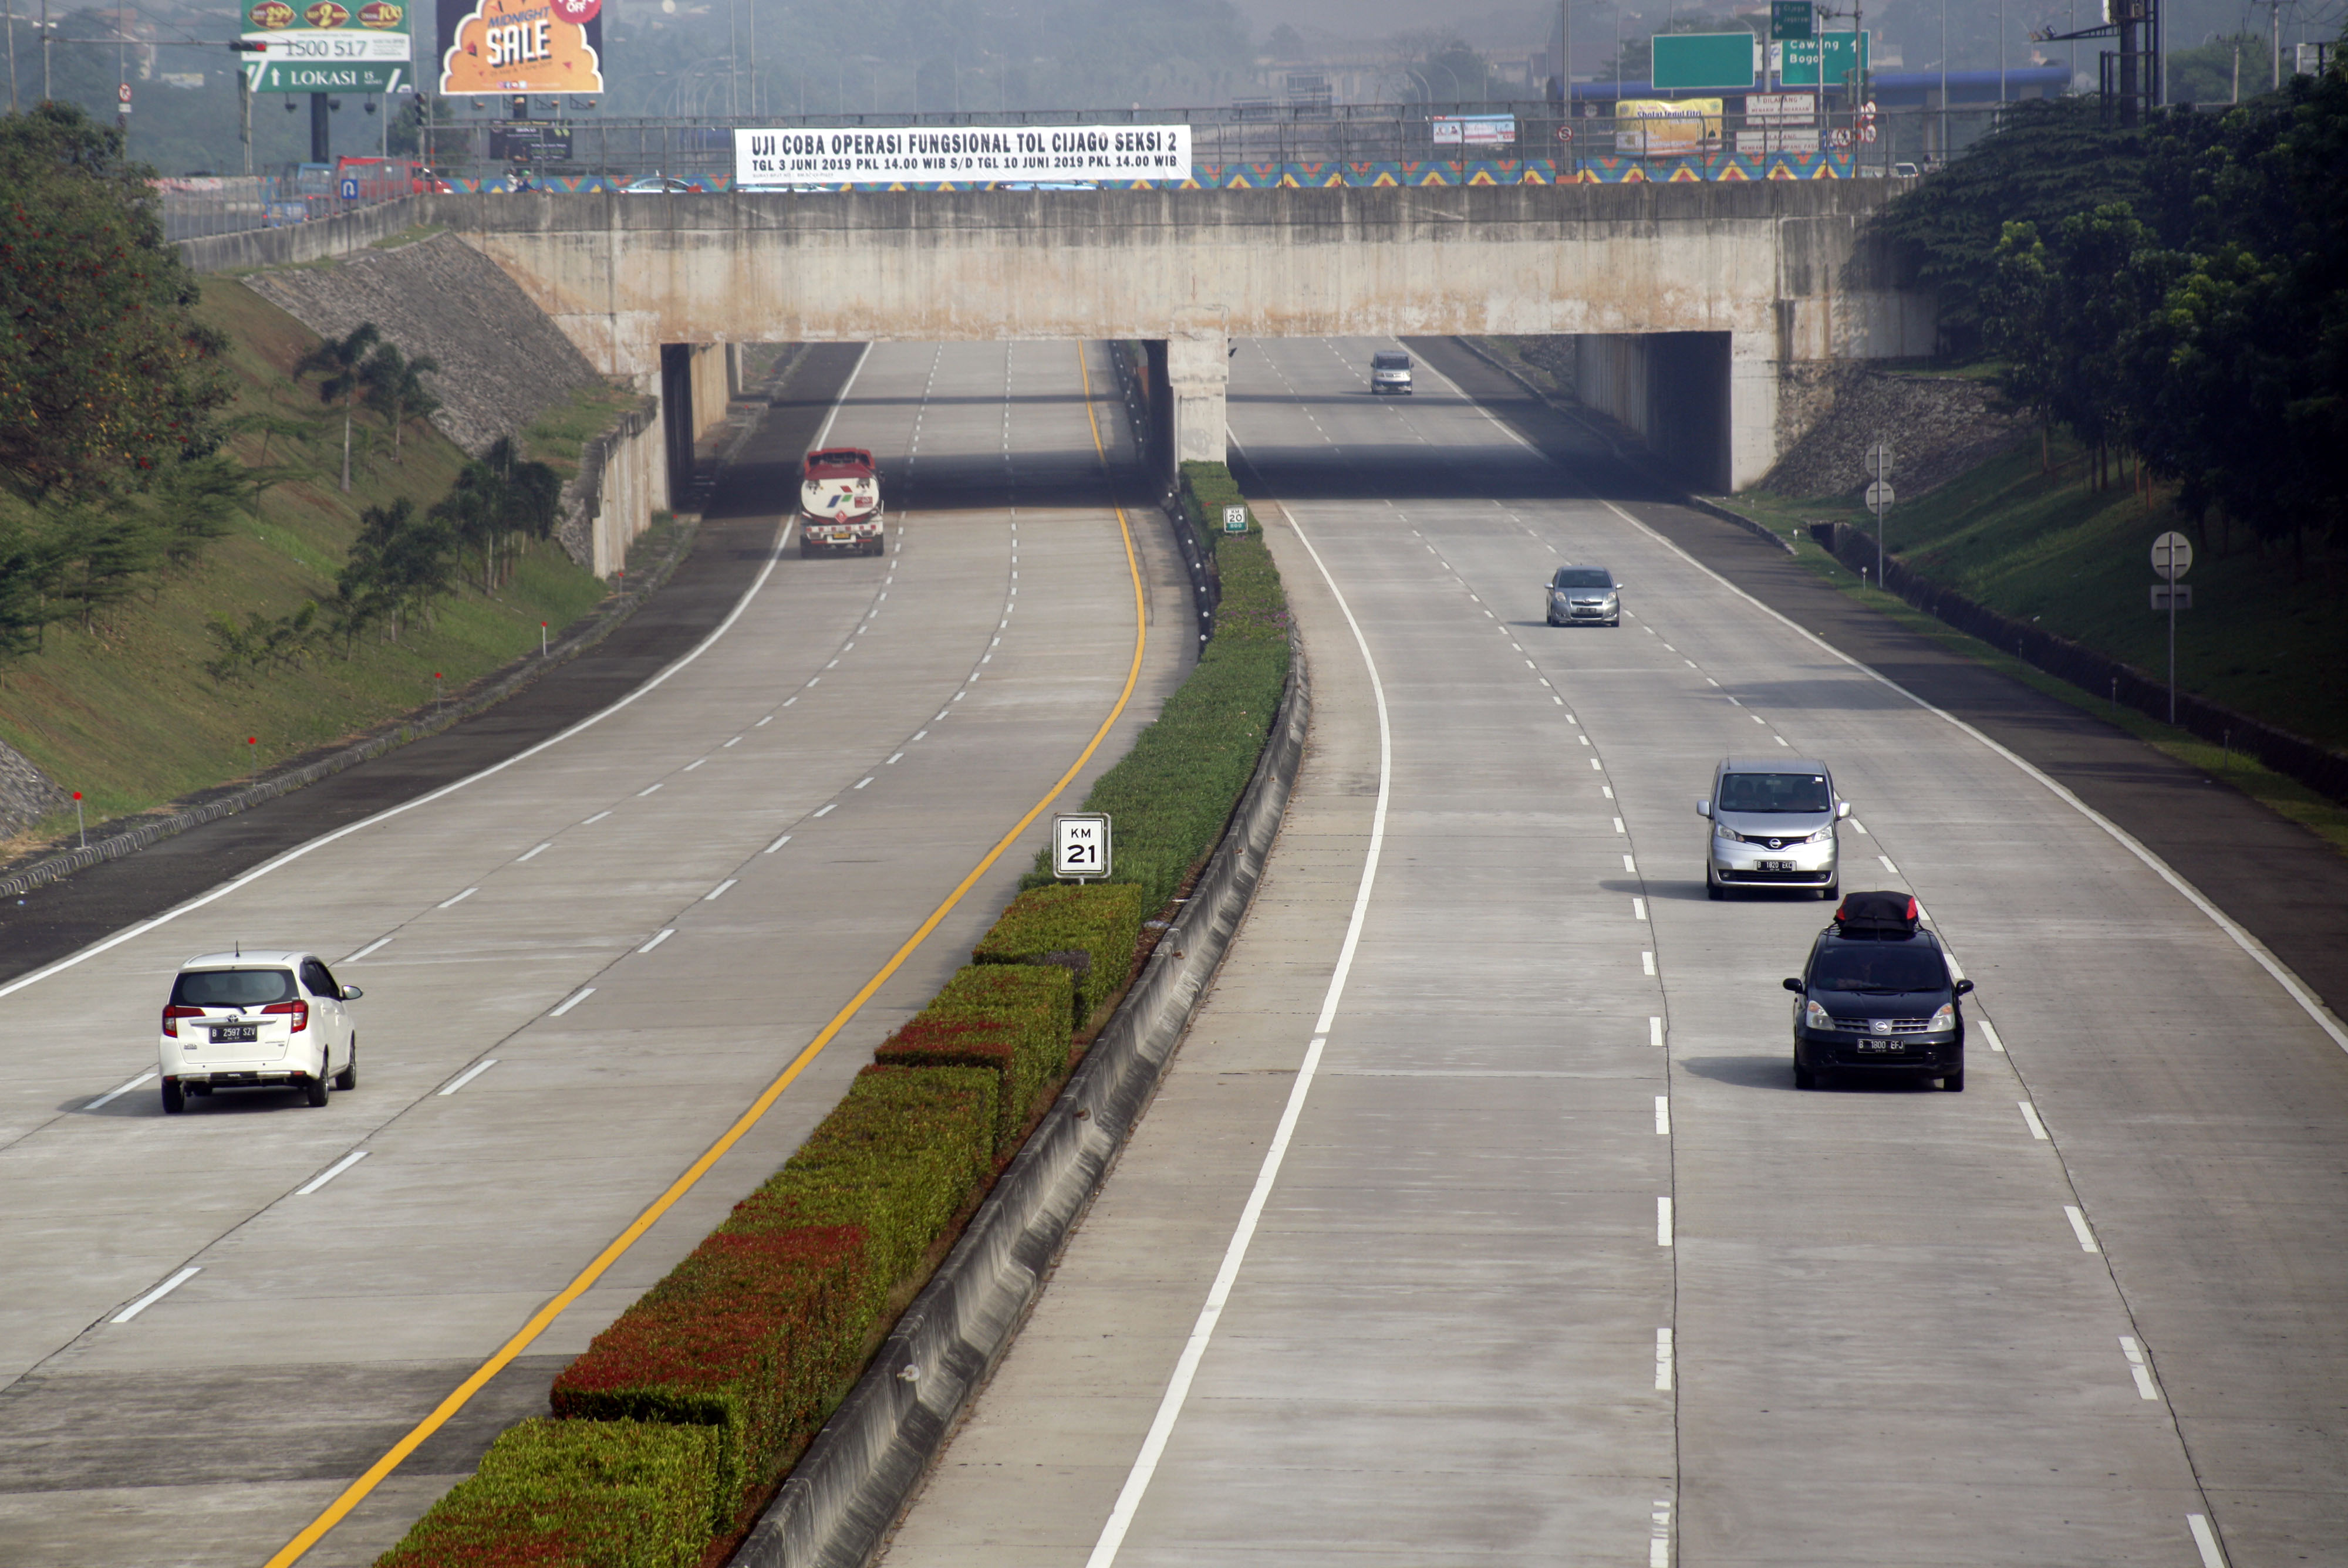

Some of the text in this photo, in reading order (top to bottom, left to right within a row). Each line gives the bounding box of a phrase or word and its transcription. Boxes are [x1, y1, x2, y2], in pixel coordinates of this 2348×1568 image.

[566, 1, 586, 13] OFF
[488, 6, 551, 28] MIDNIGHT
[286, 40, 329, 56] 1500
[335, 40, 367, 56] 517
[486, 19, 551, 67] SALE
[1790, 40, 1839, 51] Cawng
[291, 70, 356, 86] LOKASI
[752, 131, 1176, 156] UJI COBA OPERASI FUNGSIONAL TOL CIJAGO SEKSI 2
[753, 155, 1177, 171] TGL 3 JUNI 2019 PKL 14.00 WIB S/D TGL 10 JUNI 2019 PKL 14.00 WIB
[1229, 514, 1243, 522] 20
[1071, 828, 1091, 838] KM
[1067, 844, 1095, 863] 21
[212, 1028, 255, 1037] B 2597 SZV
[1859, 1040, 1903, 1049] B 1800 EFJ
